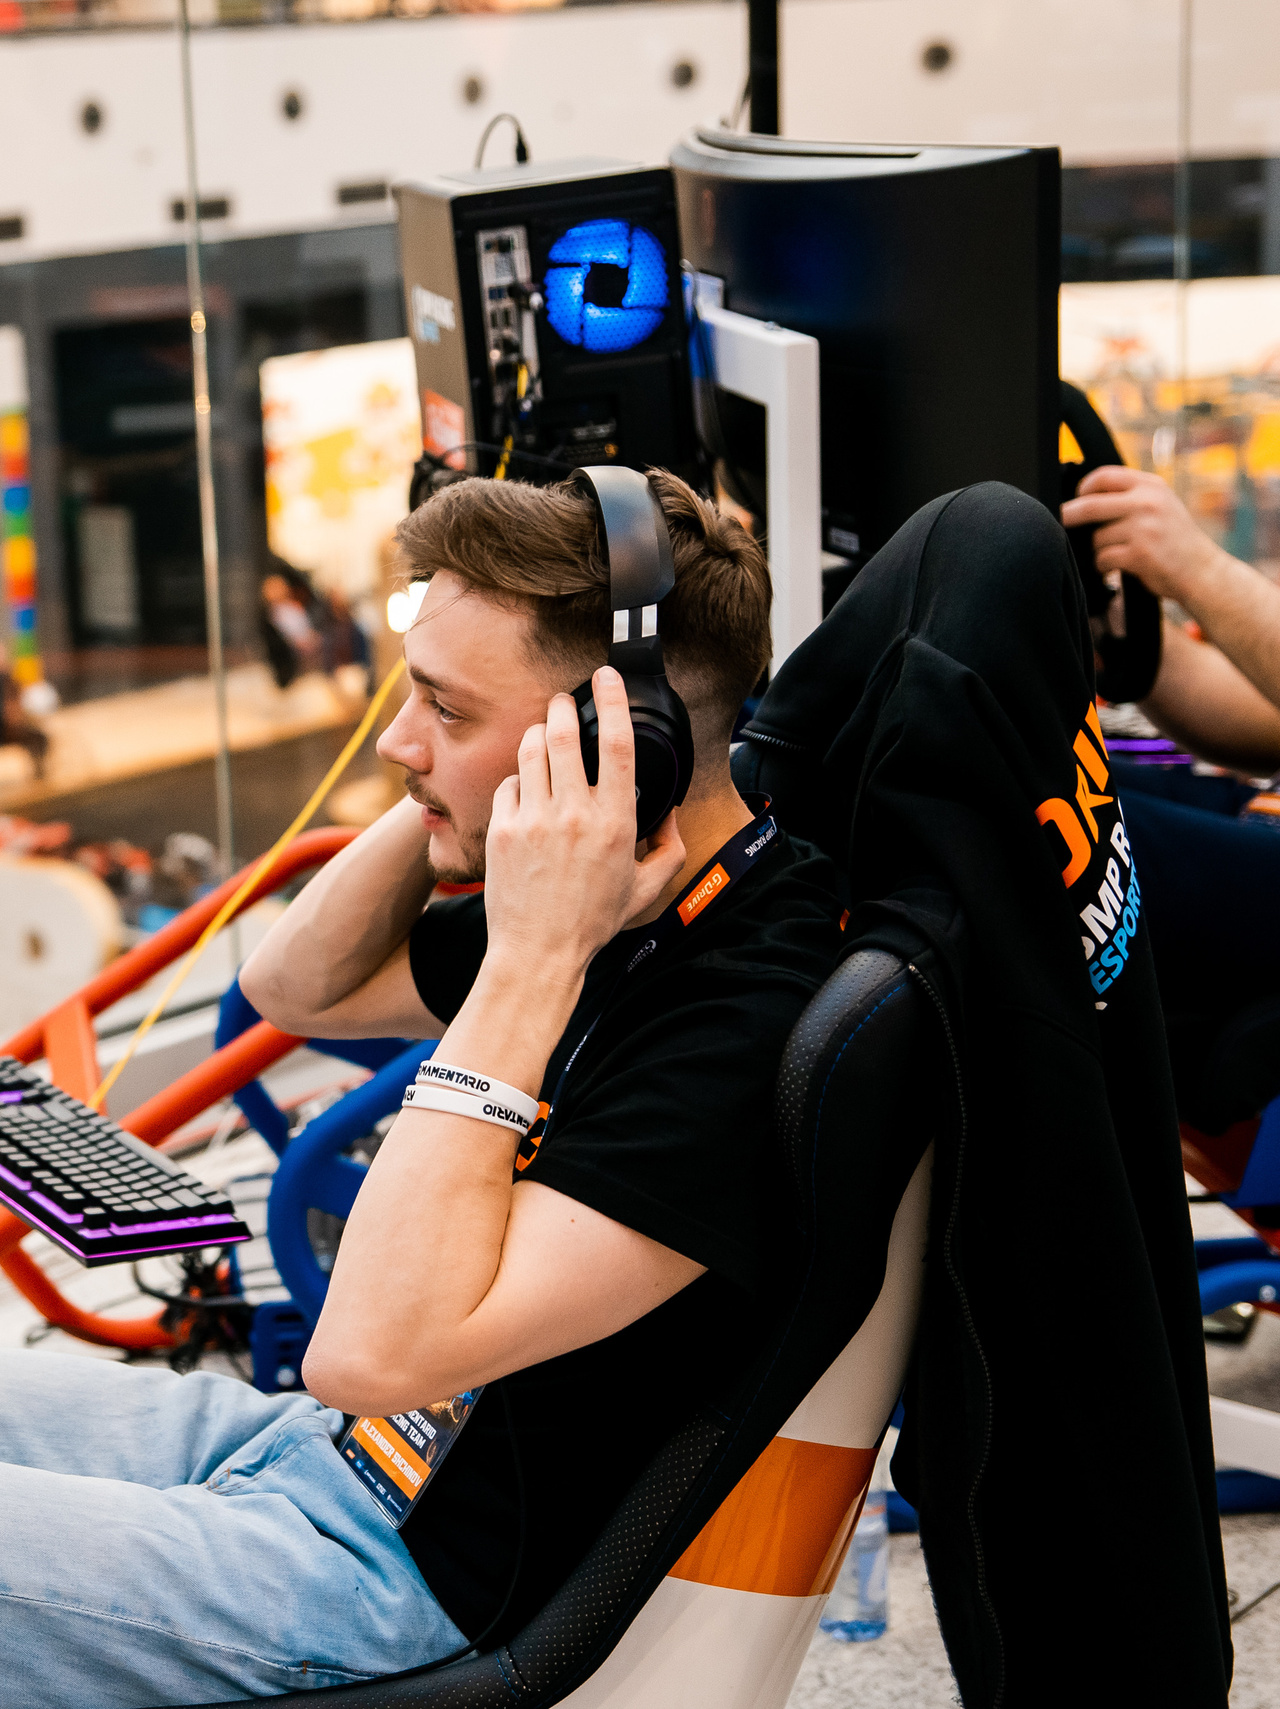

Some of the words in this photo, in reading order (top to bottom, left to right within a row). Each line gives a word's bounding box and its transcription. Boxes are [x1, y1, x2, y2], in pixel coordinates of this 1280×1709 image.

[744, 834, 767, 857] RACING
[360, 1418, 396, 1459] ALEXANDER
[406, 1424, 427, 1449] TEAM
